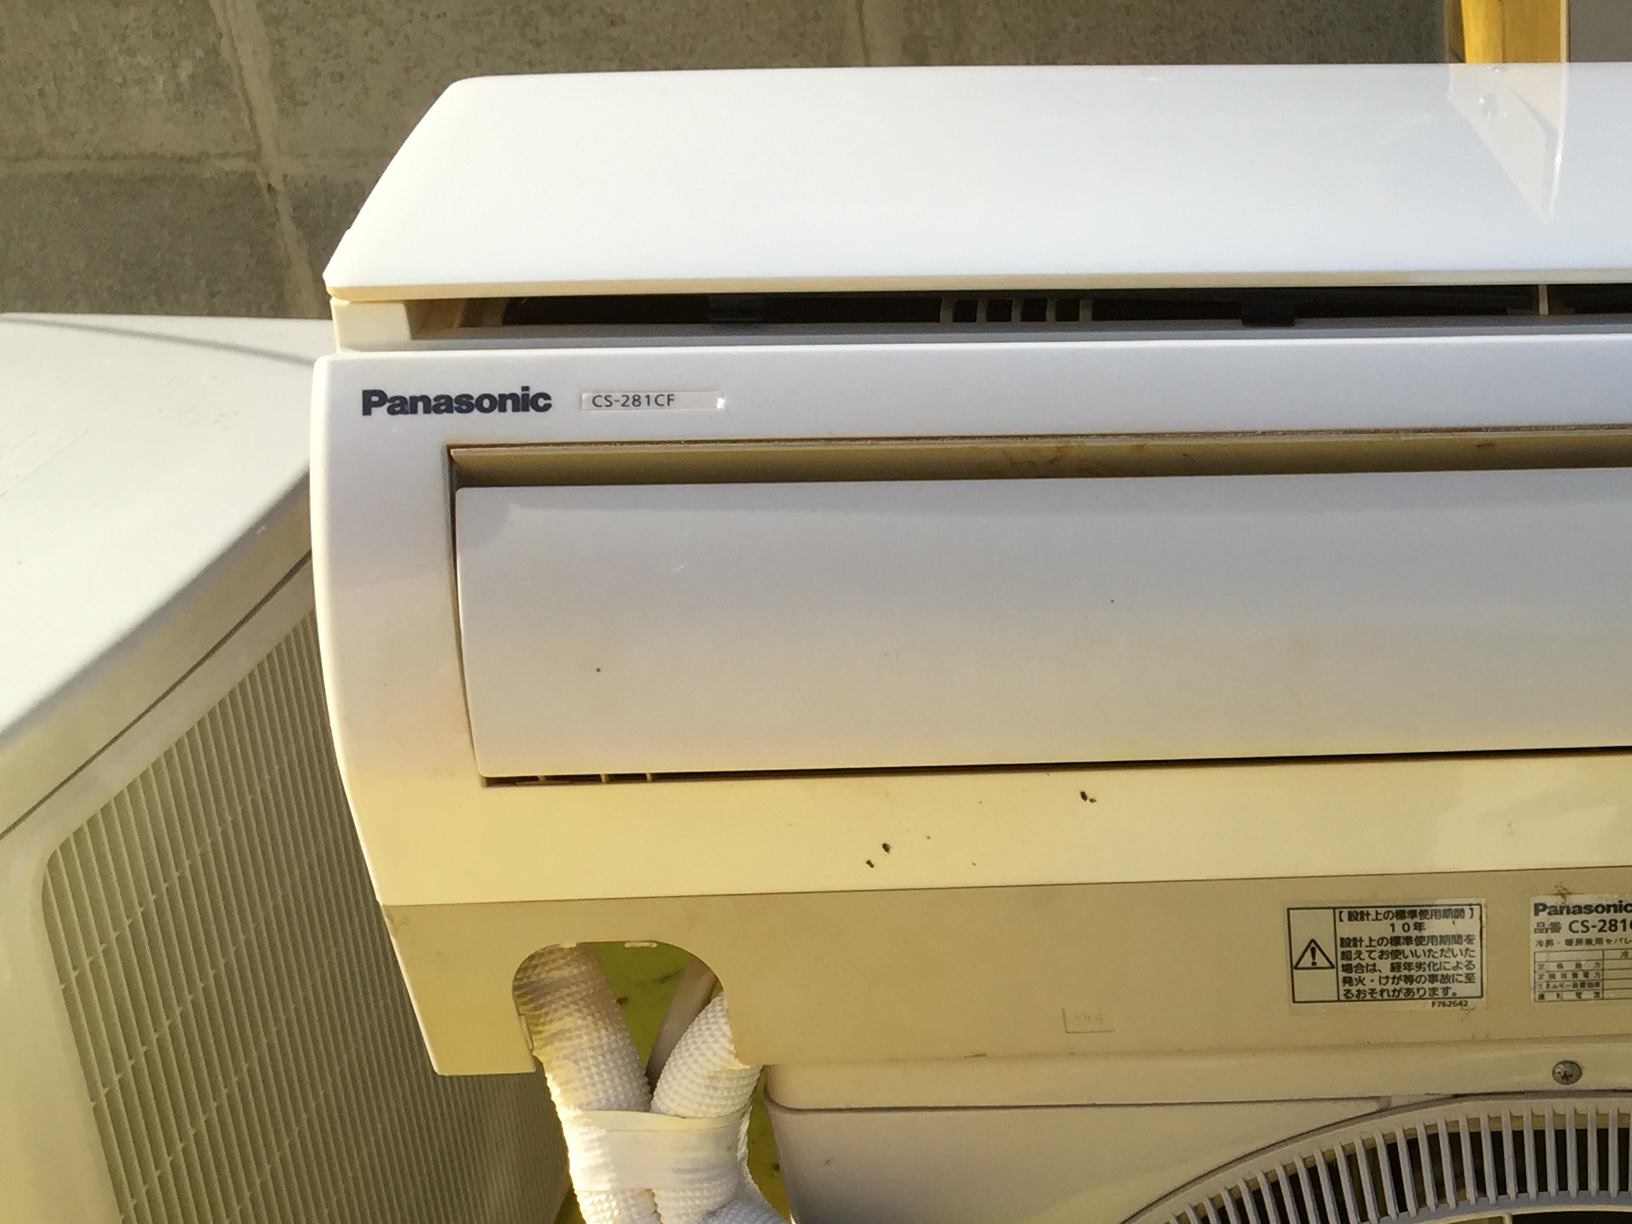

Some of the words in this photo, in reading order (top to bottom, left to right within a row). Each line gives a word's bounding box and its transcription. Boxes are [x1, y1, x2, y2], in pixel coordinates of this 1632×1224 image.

[361, 386, 552, 416] Panasonic
[591, 393, 676, 409] CS-281CF
[1533, 921, 1563, 935] 品番
[1339, 933, 1476, 948] 設計上の標準使用期間を
[1340, 947, 1477, 961] 超えてお使いいただいた
[1341, 959, 1477, 974] 場合は、経年劣化による
[1342, 973, 1477, 987] 発火・けが等の事故に至
[1343, 986, 1458, 1000] るおそれがあります。
